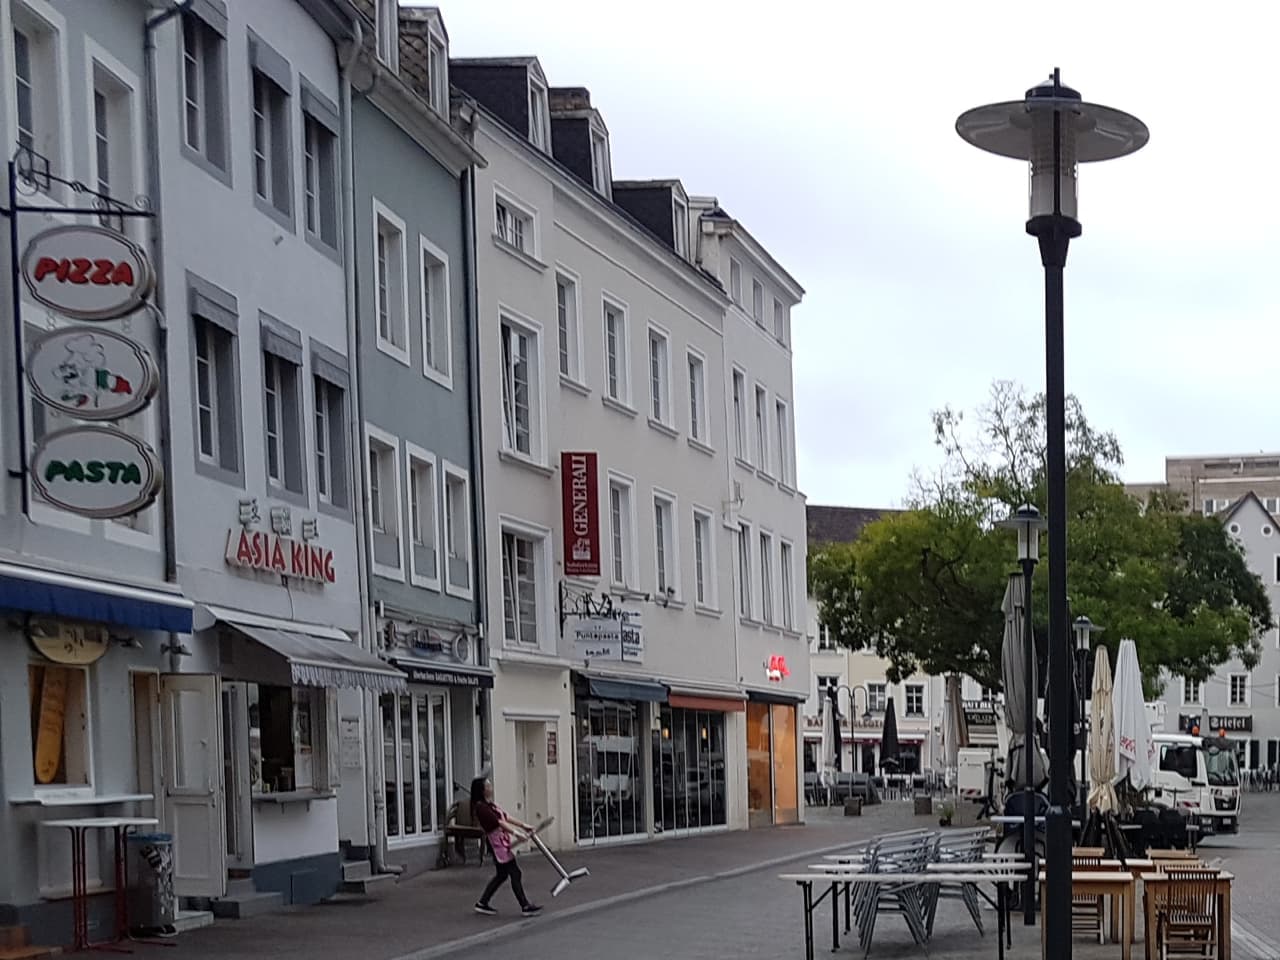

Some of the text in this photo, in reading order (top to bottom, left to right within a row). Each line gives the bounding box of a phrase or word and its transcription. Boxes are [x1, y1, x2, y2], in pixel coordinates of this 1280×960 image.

[34, 257, 134, 287] PIZZA
[45, 460, 142, 486] PASTA
[572, 455, 588, 536] GENERALI
[237, 529, 335, 583] ASIA KING
